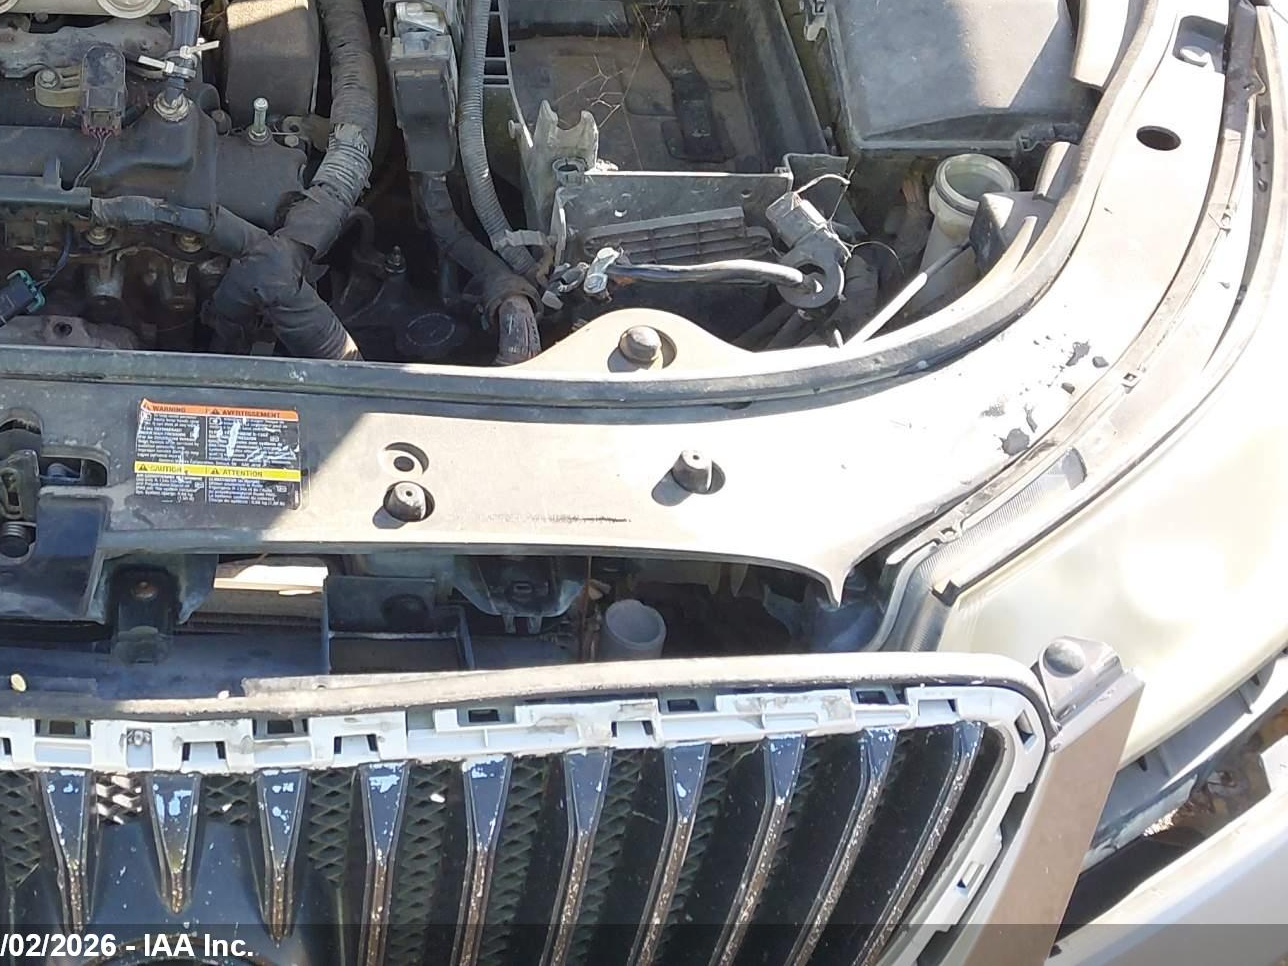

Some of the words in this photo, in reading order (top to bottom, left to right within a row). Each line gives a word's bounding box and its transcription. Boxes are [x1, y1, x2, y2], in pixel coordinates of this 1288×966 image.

[152, 405, 186, 413] WARNING
[222, 409, 281, 418] AVERTISSEMENT
[150, 465, 182, 473] CAUTION
[222, 469, 263, 478] ATTENTION
